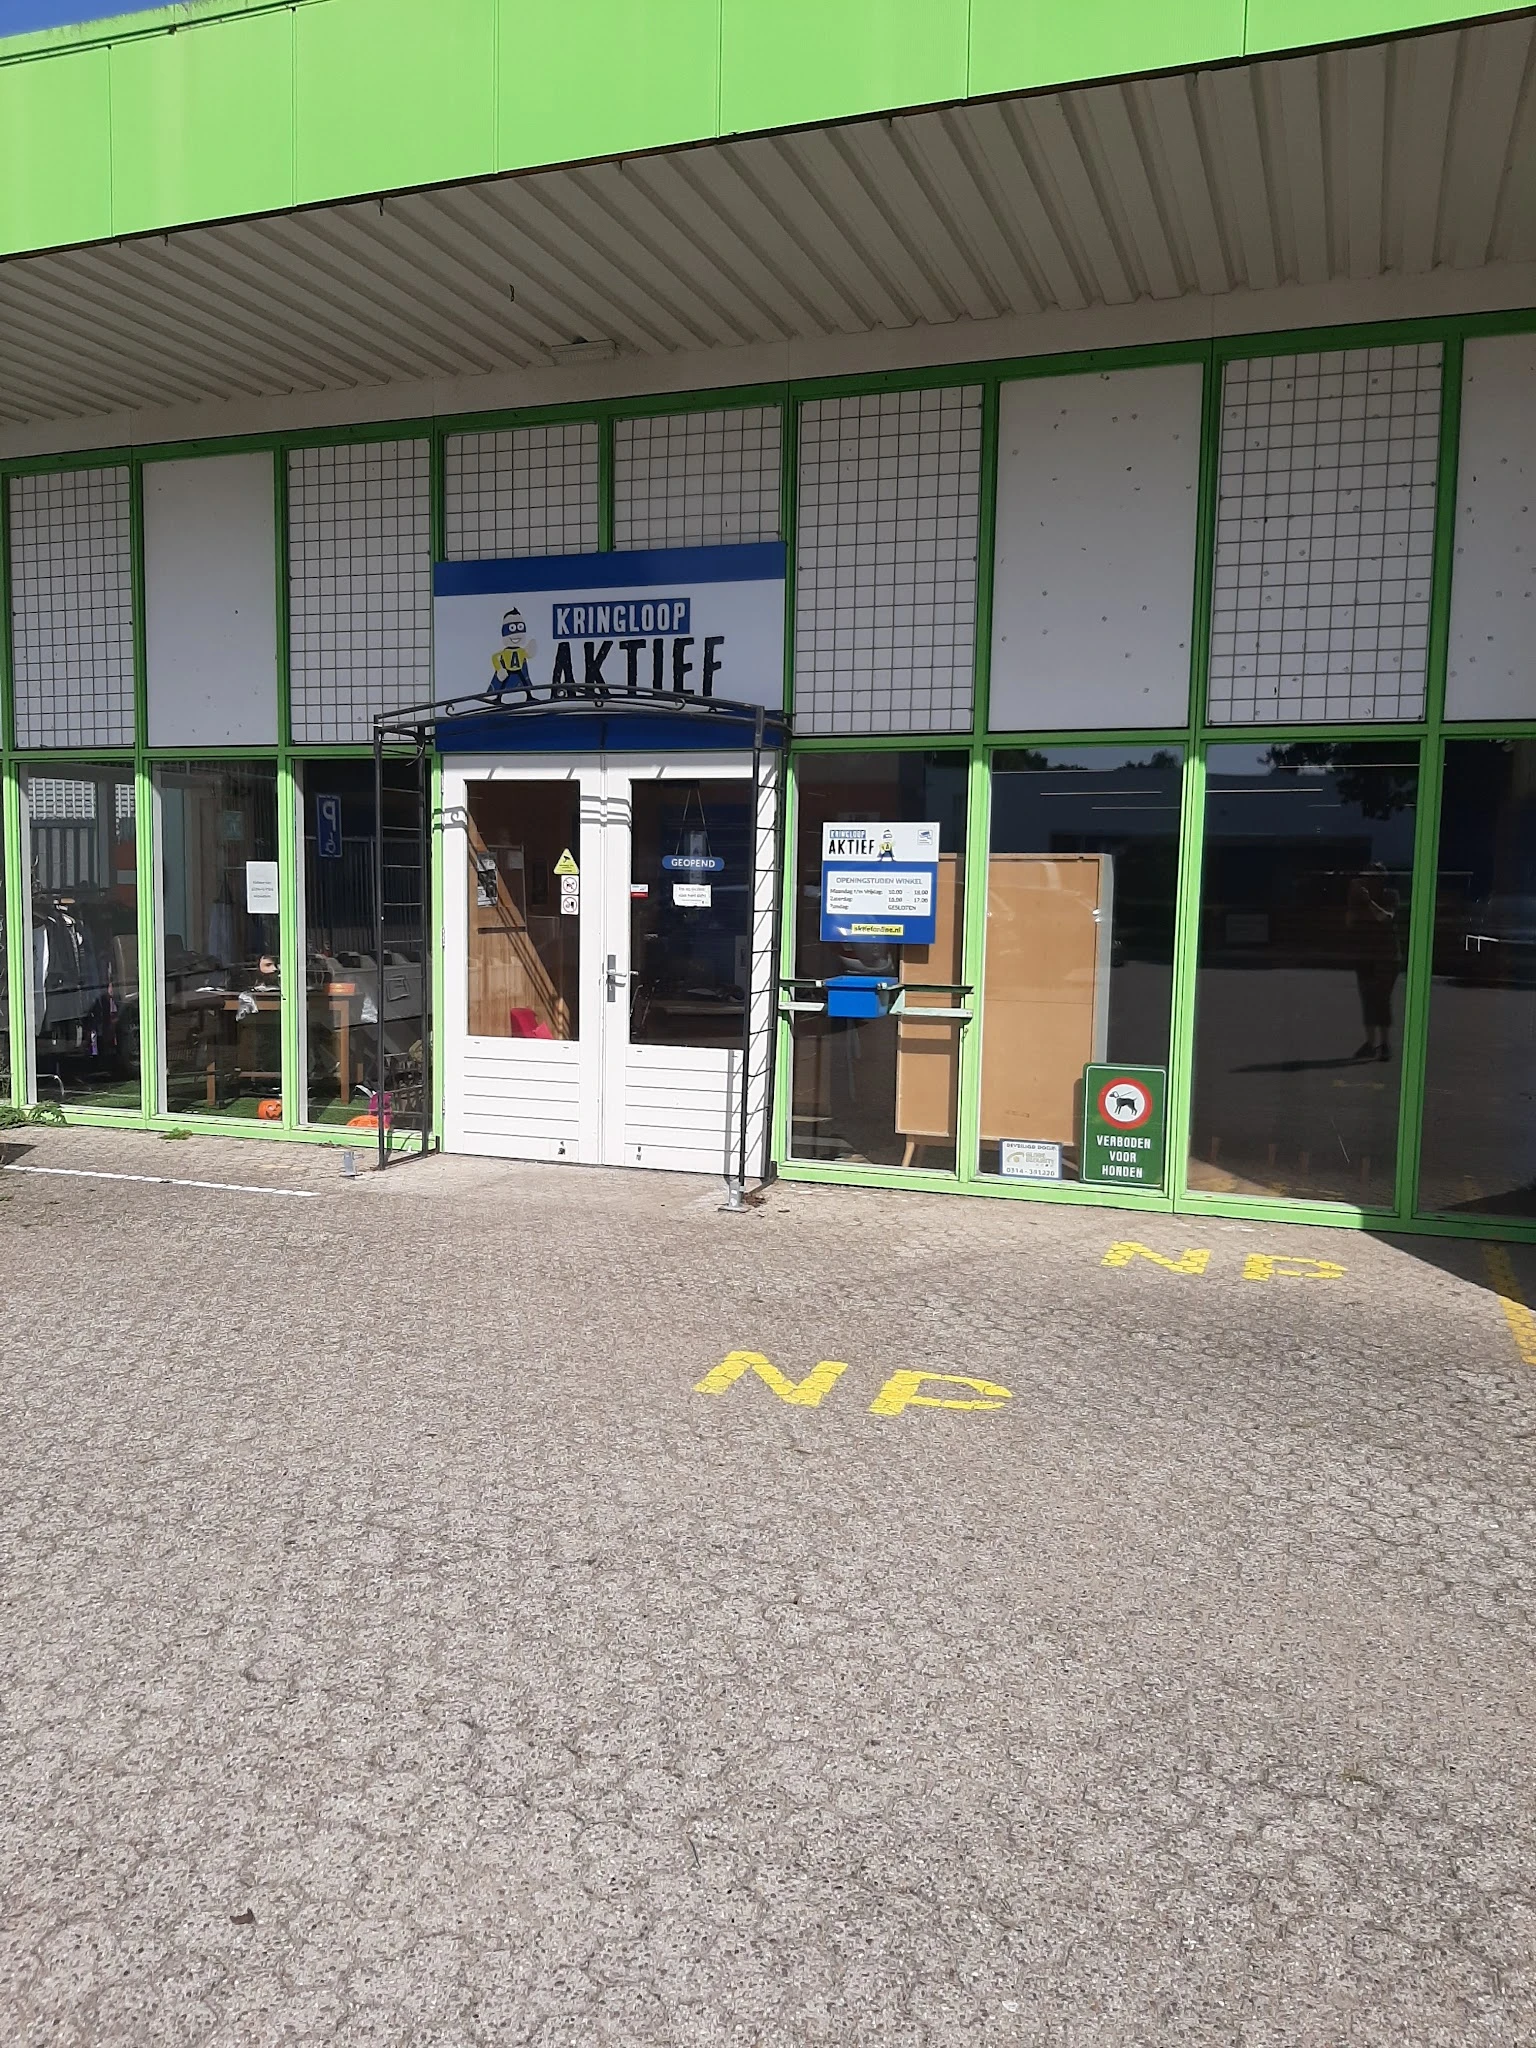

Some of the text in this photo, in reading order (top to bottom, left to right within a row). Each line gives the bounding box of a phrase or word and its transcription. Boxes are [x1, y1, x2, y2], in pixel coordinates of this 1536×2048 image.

[556, 602, 687, 636] KRINGLOOP
[509, 650, 521, 669] A
[551, 635, 725, 699] AKTIEF
[829, 840, 875, 854] AKTIEF
[671, 858, 716, 868] GEOPEND
[1096, 1135, 1151, 1149] VERBODEN
[1109, 1150, 1137, 1163] VOOR
[1101, 1164, 1143, 1178] HONDEN
